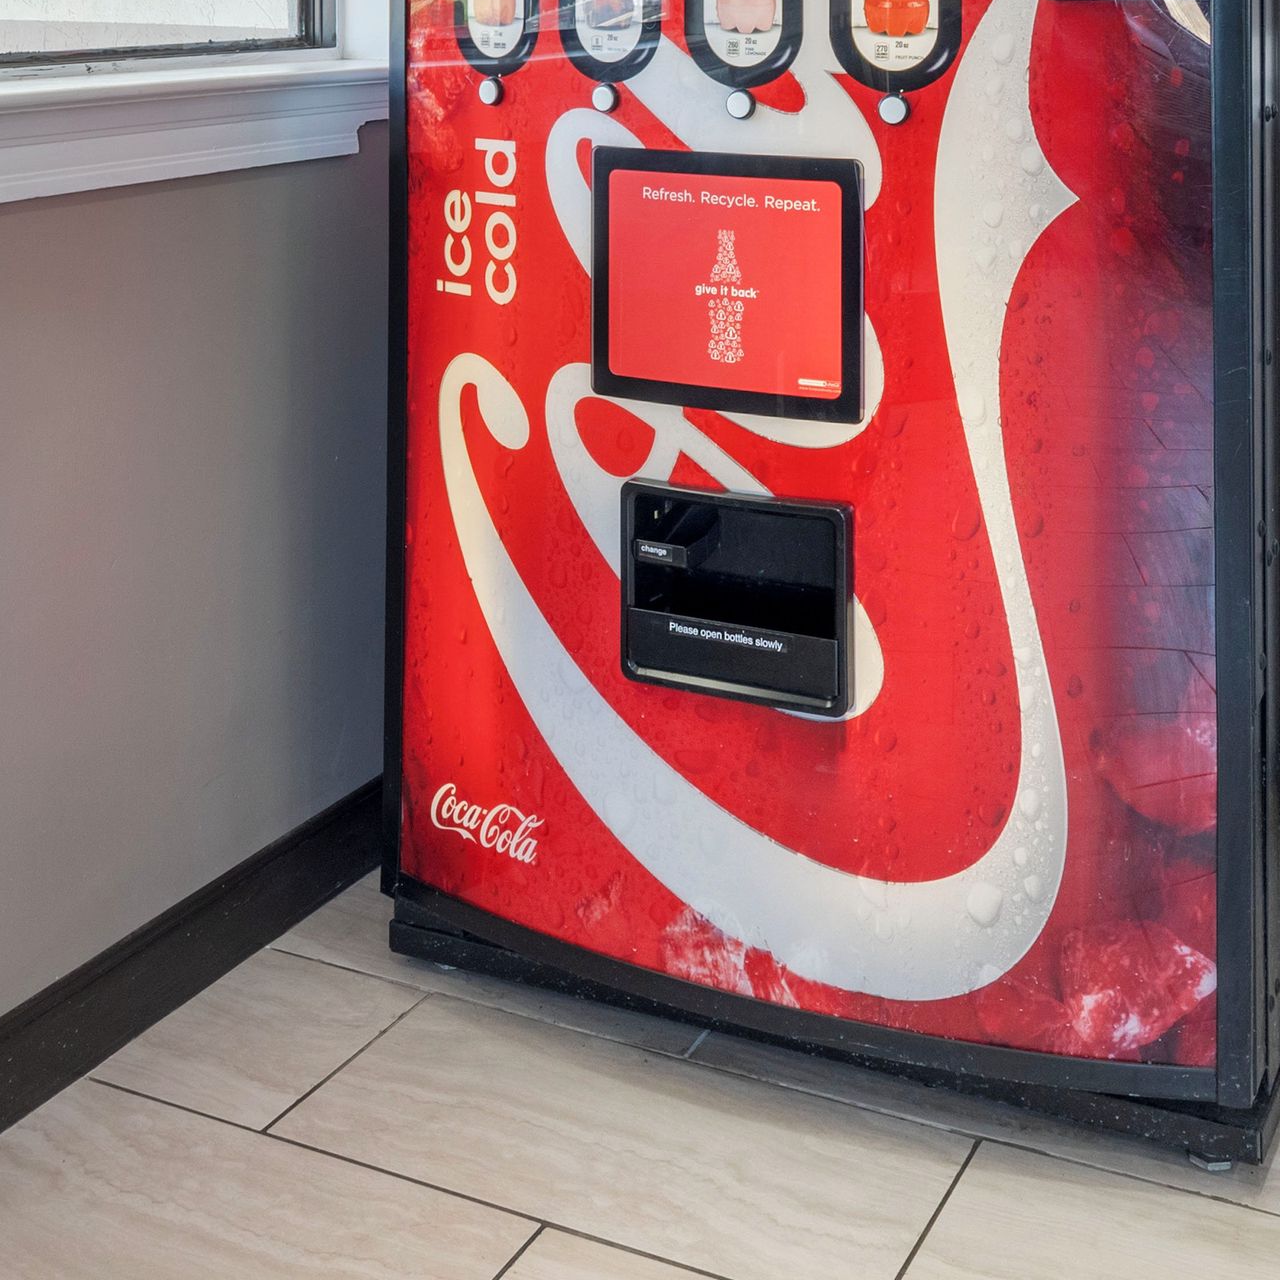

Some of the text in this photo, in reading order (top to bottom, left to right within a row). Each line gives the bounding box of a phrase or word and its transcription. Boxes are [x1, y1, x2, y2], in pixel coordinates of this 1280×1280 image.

[642, 186, 820, 212] Refresh. Recycle. Repeat.
[475, 138, 517, 305] cold
[436, 189, 472, 296] ice
[695, 284, 756, 298] give it back
[641, 544, 666, 556] change
[669, 622, 783, 652] Please open bottles slowly
[430, 783, 545, 864] Coca-Cola
